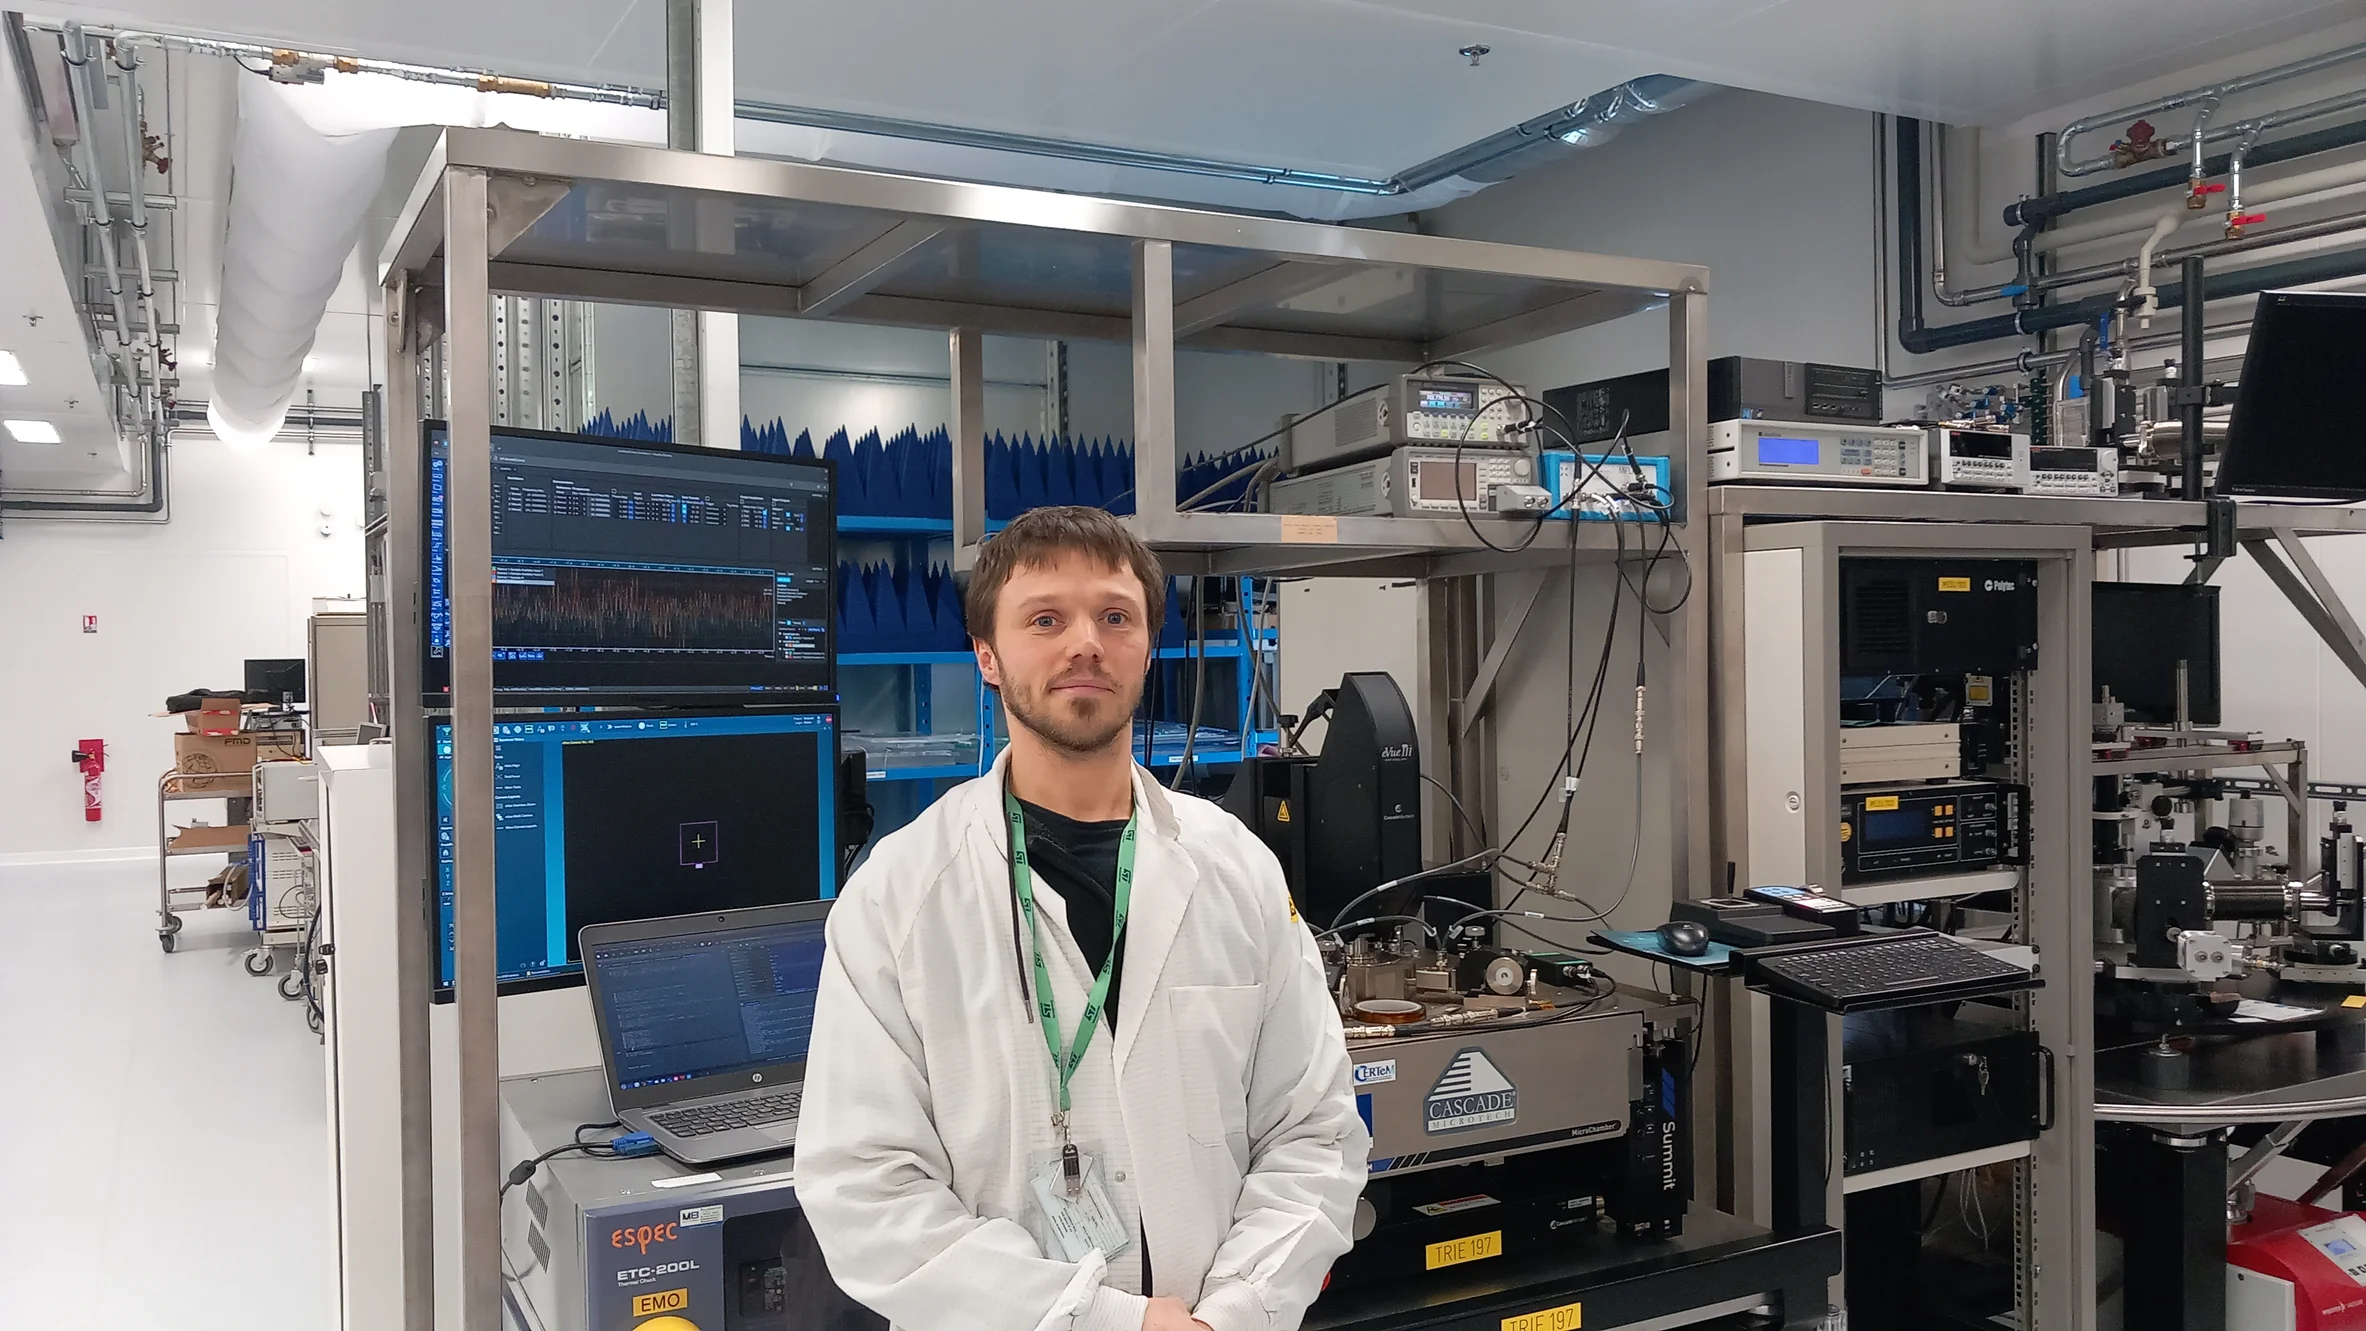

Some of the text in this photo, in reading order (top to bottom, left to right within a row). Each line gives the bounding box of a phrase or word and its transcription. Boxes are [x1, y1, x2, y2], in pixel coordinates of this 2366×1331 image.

[1429, 1091, 1514, 1119] CASCADE
[1432, 1110, 1511, 1129] MICROTECH
[1662, 1121, 1676, 1191] Summit
[1436, 1236, 1492, 1263] TRIE 197
[617, 1259, 700, 1281] ETC-200L
[641, 1293, 680, 1312] EMO
[1549, 1308, 1574, 1330] 197
